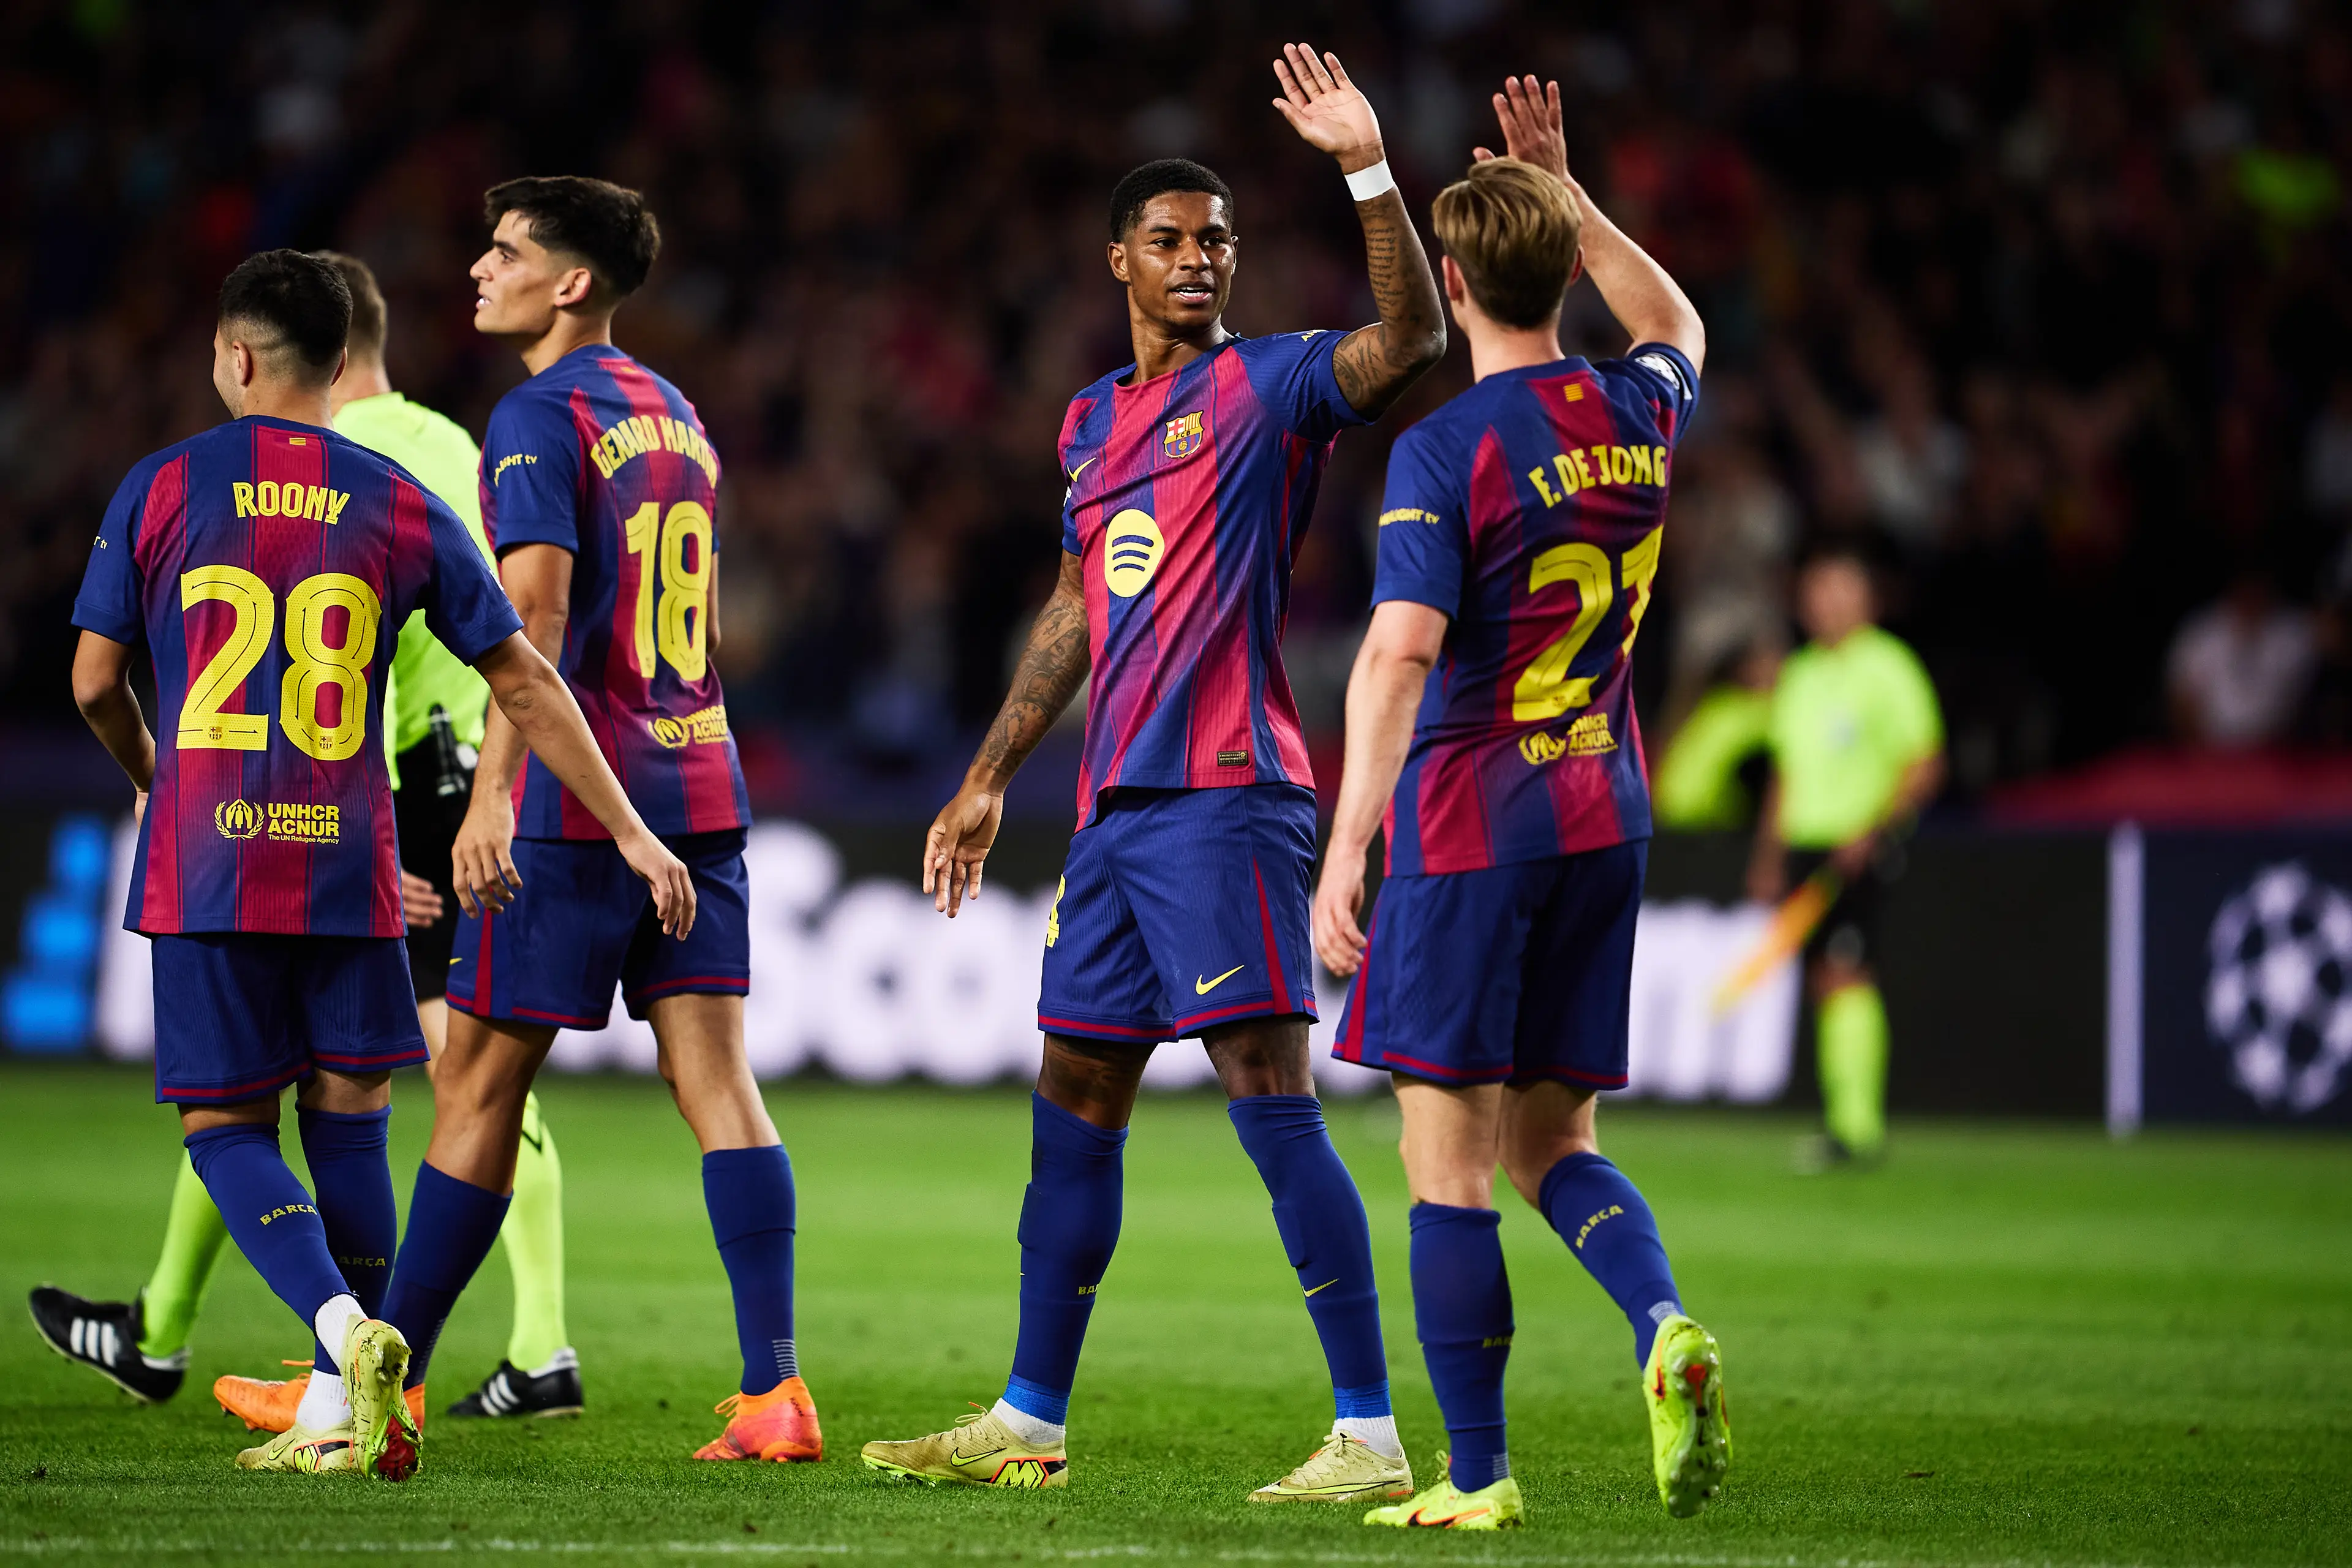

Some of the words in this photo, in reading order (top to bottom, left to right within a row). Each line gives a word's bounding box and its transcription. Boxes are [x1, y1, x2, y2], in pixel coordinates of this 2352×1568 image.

[590, 415, 662, 479] GERARD
[1553, 448, 1596, 489] DE
[1591, 445, 1667, 487] JONG
[232, 481, 350, 525] ROONY
[625, 500, 712, 682] 18
[1512, 524, 1664, 722] 21
[176, 565, 383, 761] 28
[267, 819, 340, 837] ACNUR
[268, 802, 340, 821] UNHCR
[260, 1204, 318, 1226] BARÇA
[337, 1256, 386, 1267] ARÇA
